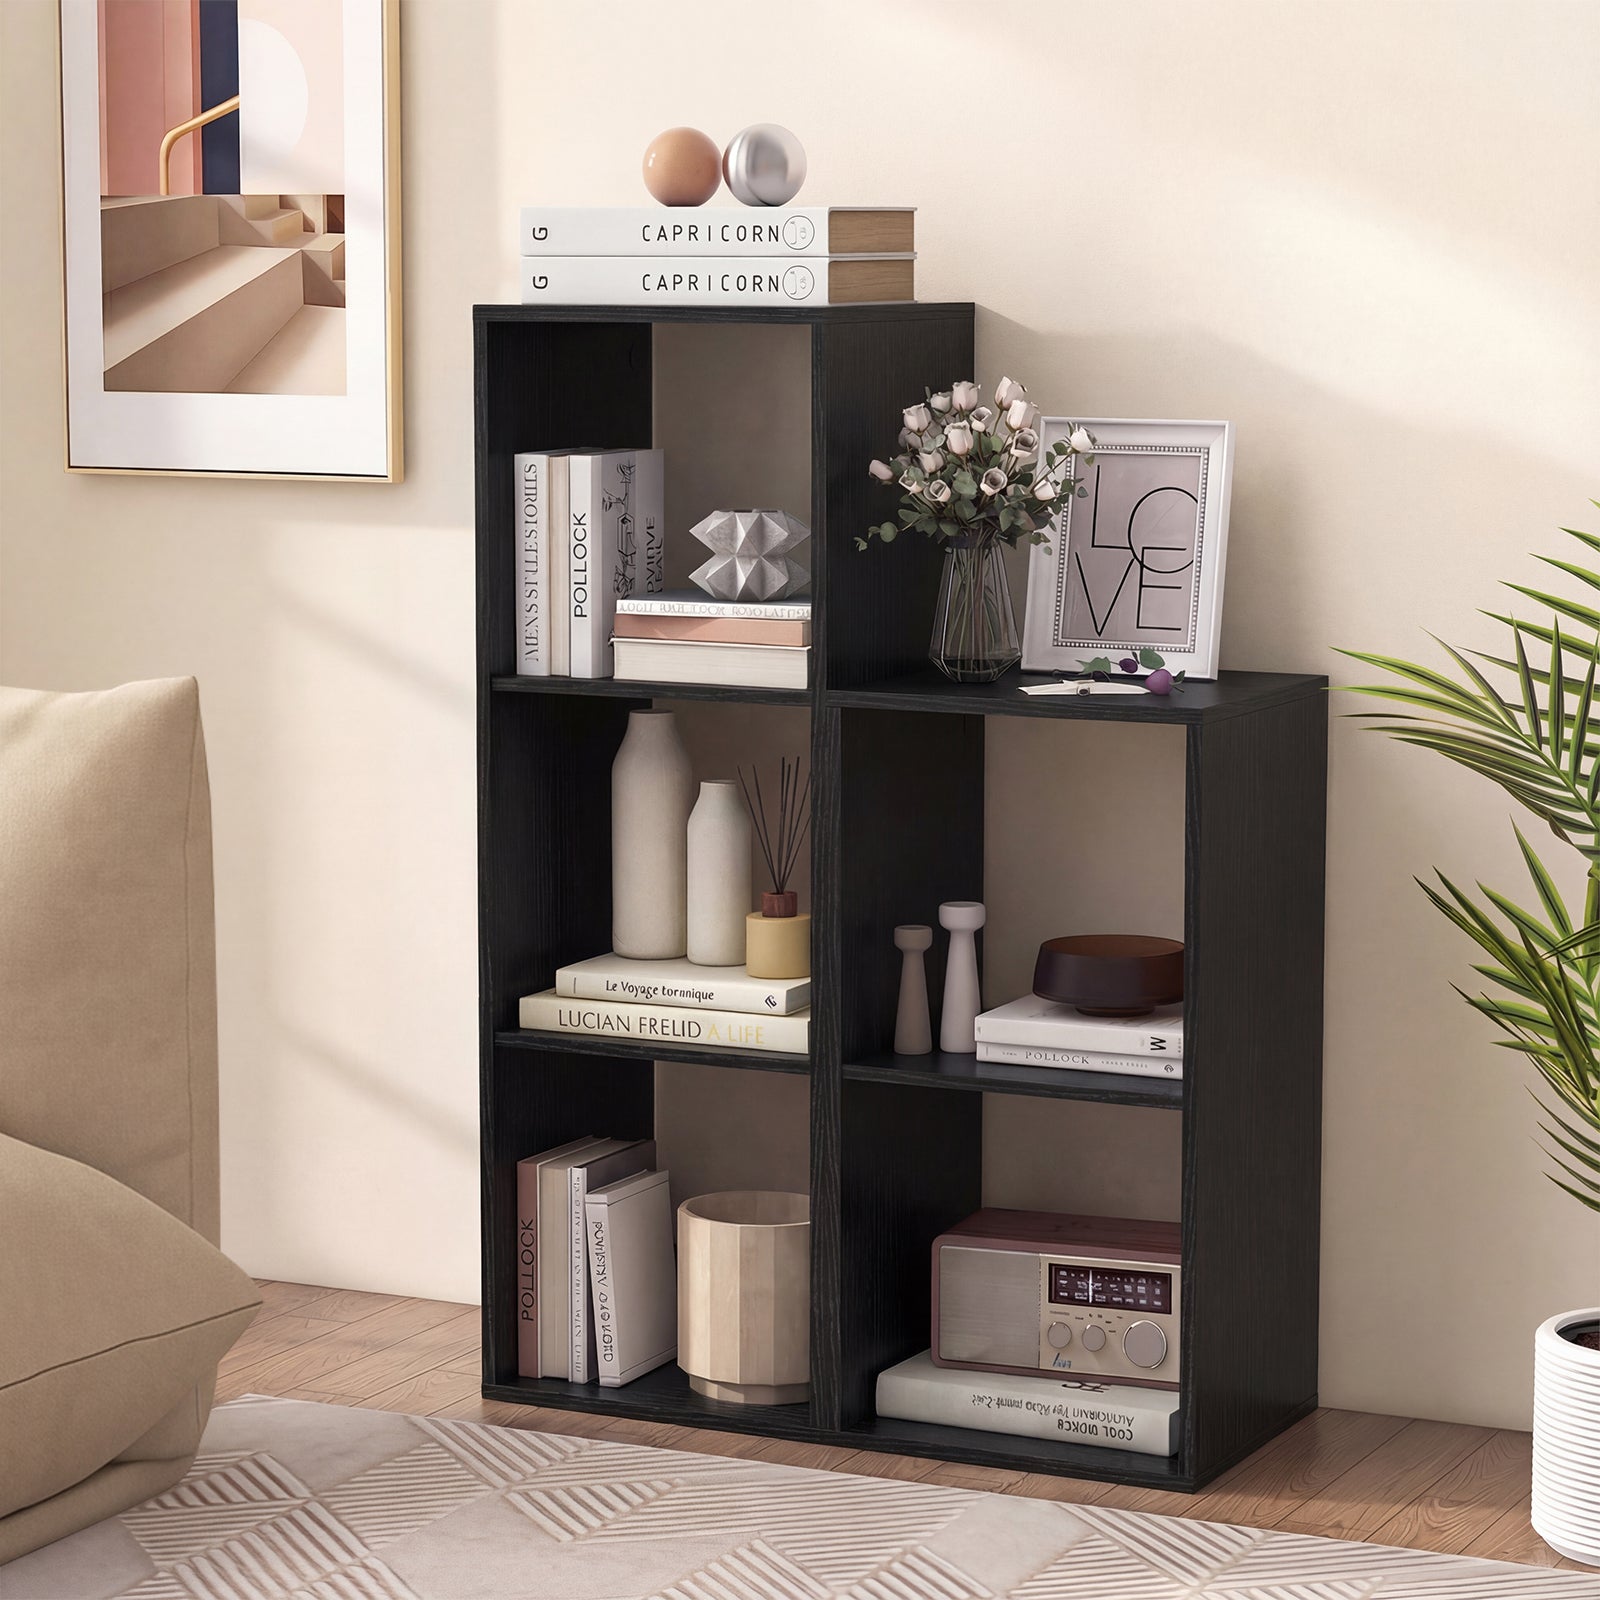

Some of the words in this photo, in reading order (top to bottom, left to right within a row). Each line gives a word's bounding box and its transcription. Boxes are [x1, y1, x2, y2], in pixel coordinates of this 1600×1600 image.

[642, 224, 779, 243] CAPRICORN
[642, 273, 779, 293] CAPRICORN
[573, 512, 588, 618] POLLOCK
[606, 980, 618, 992] Le
[620, 981, 659, 1000] Voyage
[558, 1009, 631, 1032] LUCIAN
[706, 1023, 721, 1041] A
[728, 1023, 765, 1045] LIFE
[1025, 1050, 1091, 1065] POLLOCK
[521, 1218, 535, 1322] POLLOCK
